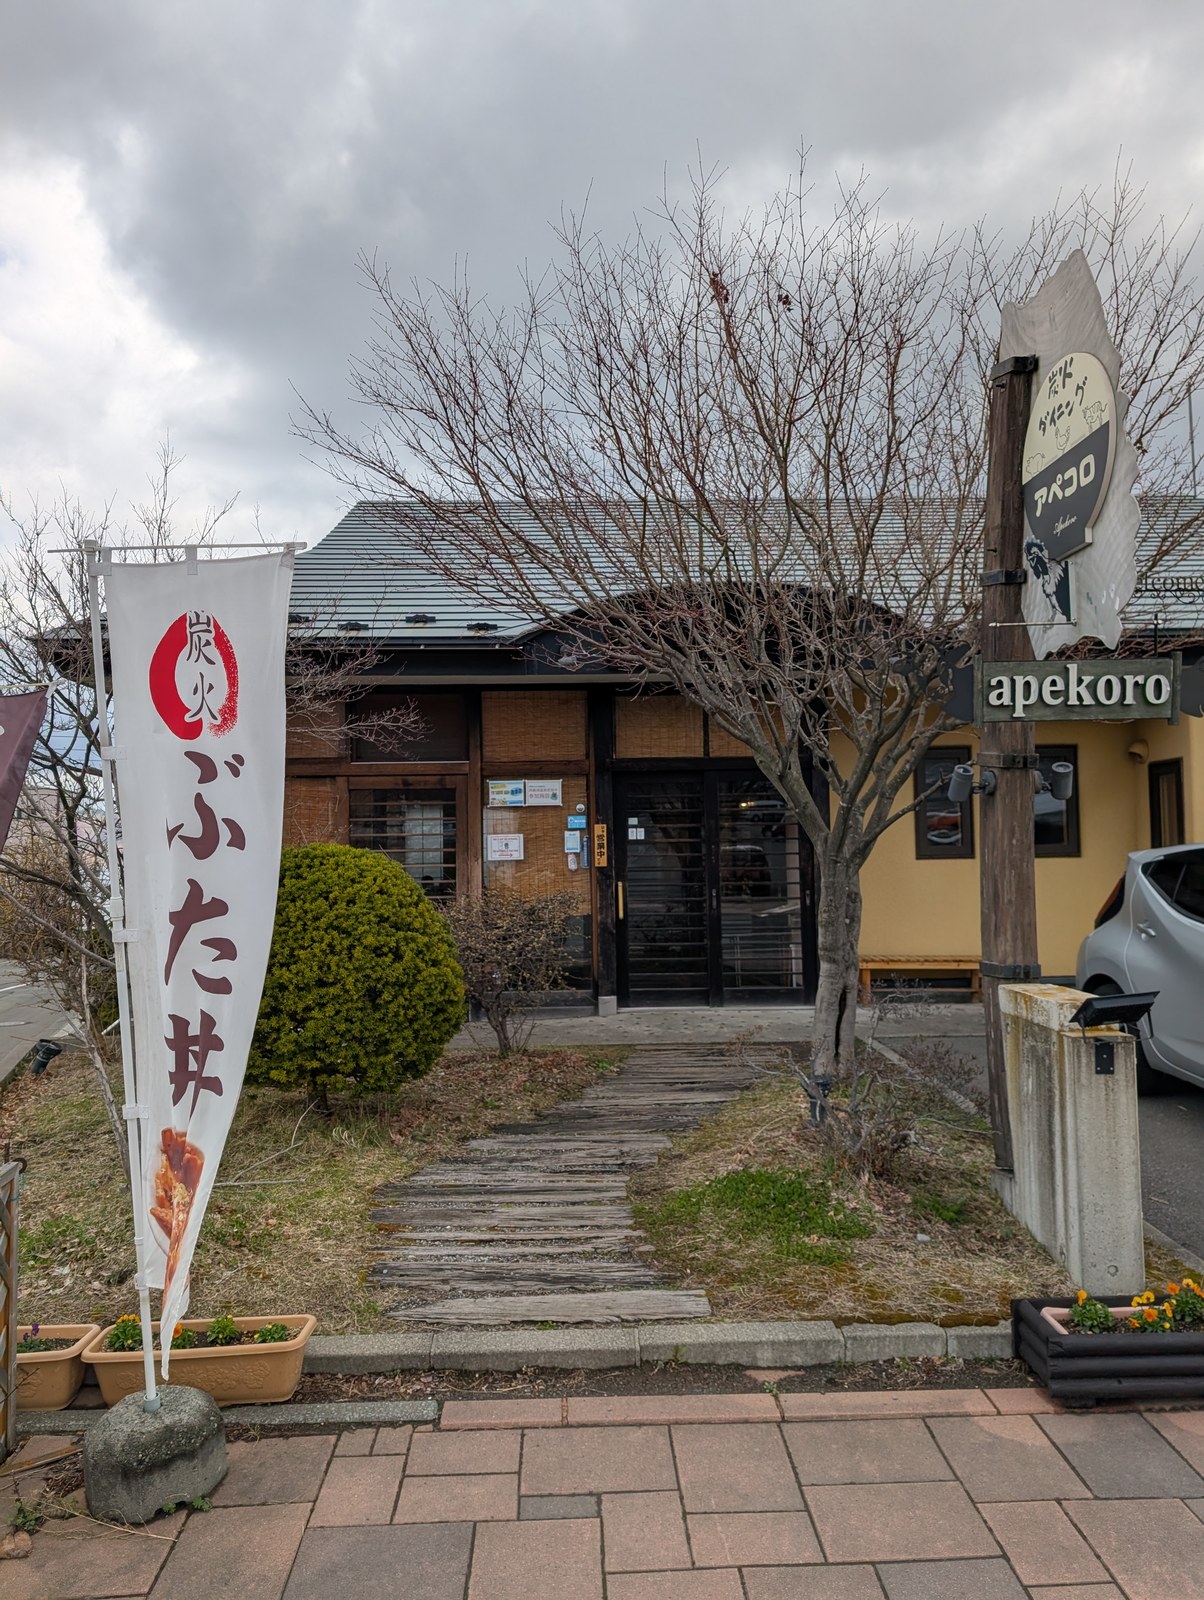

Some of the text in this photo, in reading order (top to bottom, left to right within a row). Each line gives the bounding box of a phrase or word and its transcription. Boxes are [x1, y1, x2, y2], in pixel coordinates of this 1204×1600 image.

[1038, 375, 1088, 437] ダイニング
[1034, 453, 1096, 518] アペコロ
[186, 609, 218, 721] 炭火
[988, 663, 1171, 718] apekoro
[163, 750, 247, 1122] ぶた丼
